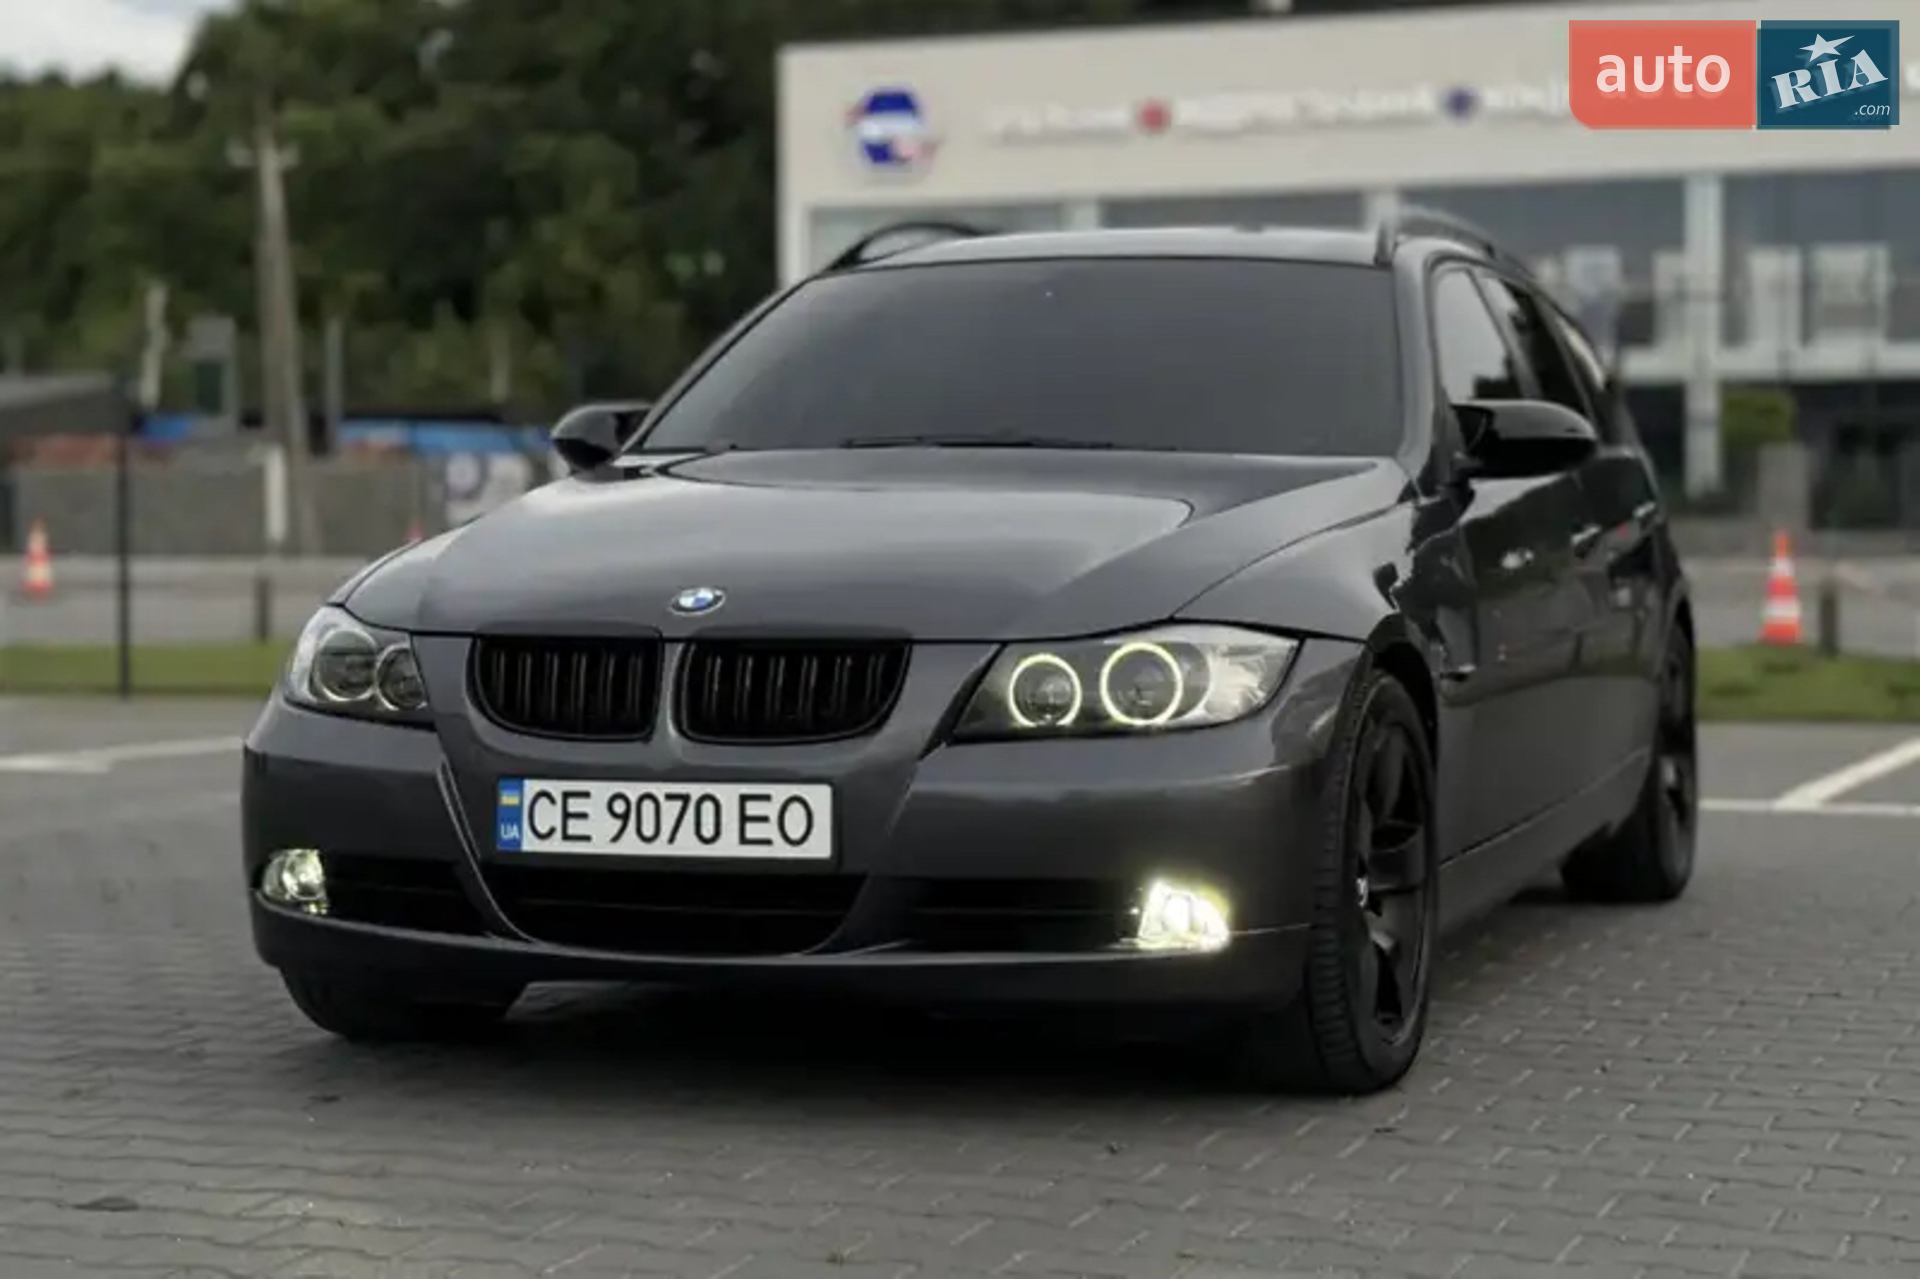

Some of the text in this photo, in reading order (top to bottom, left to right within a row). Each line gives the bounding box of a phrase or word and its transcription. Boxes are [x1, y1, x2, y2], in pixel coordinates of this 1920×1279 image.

[501, 823, 519, 840] UA
[527, 789, 814, 847] CE 9070 EO
